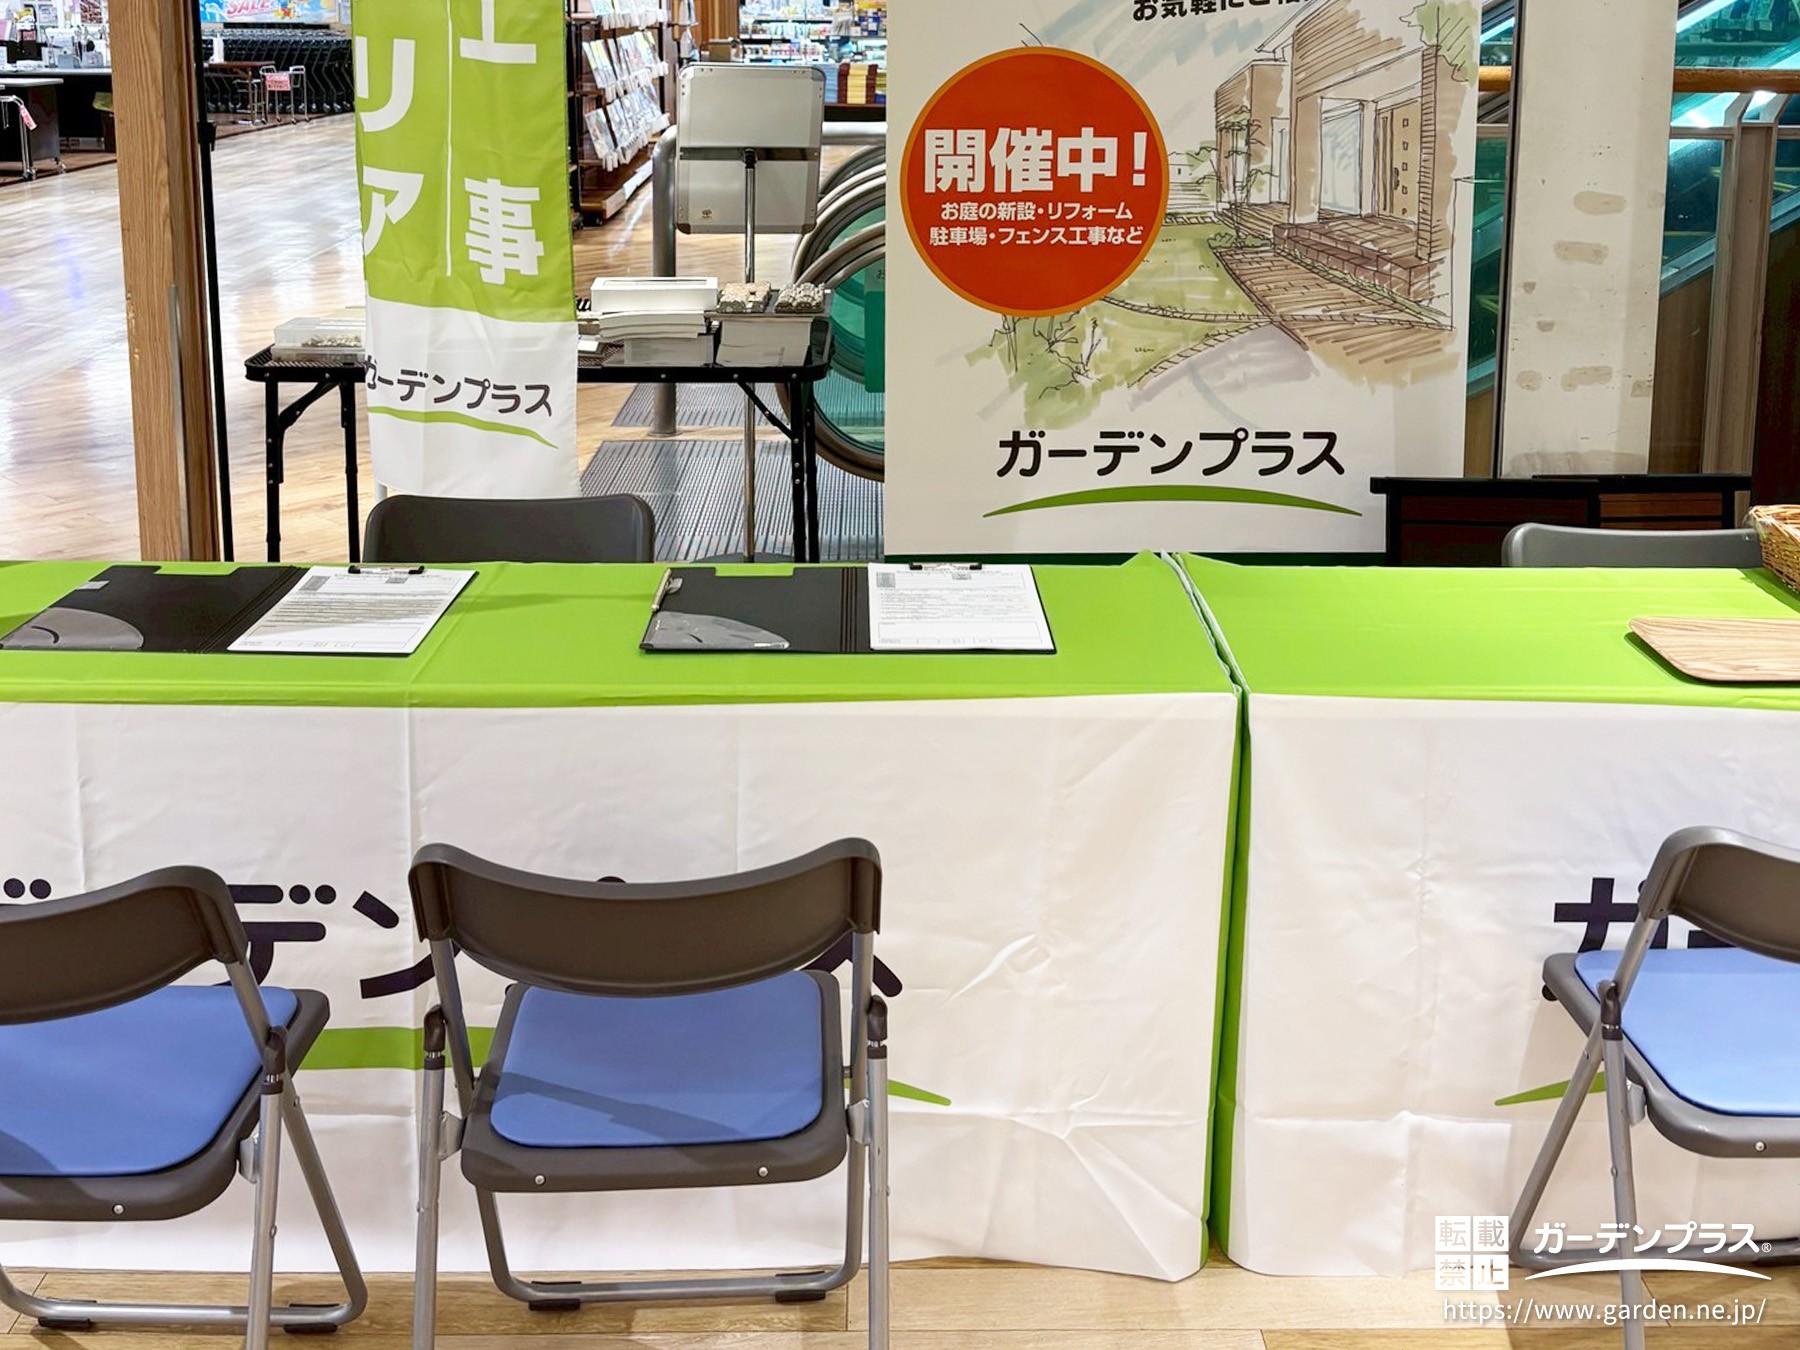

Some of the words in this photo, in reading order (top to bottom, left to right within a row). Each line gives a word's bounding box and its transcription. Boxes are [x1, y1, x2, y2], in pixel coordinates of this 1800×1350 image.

[459, 0, 545, 285] 工事
[924, 127, 1148, 194] 開催中！
[929, 225, 1144, 246] 駐車場・フェンス工事など
[941, 201, 1133, 221] お庭の新設・リフォーム
[363, 354, 553, 417] ガーデンプラス
[996, 427, 1346, 478] ガーデンプラス
